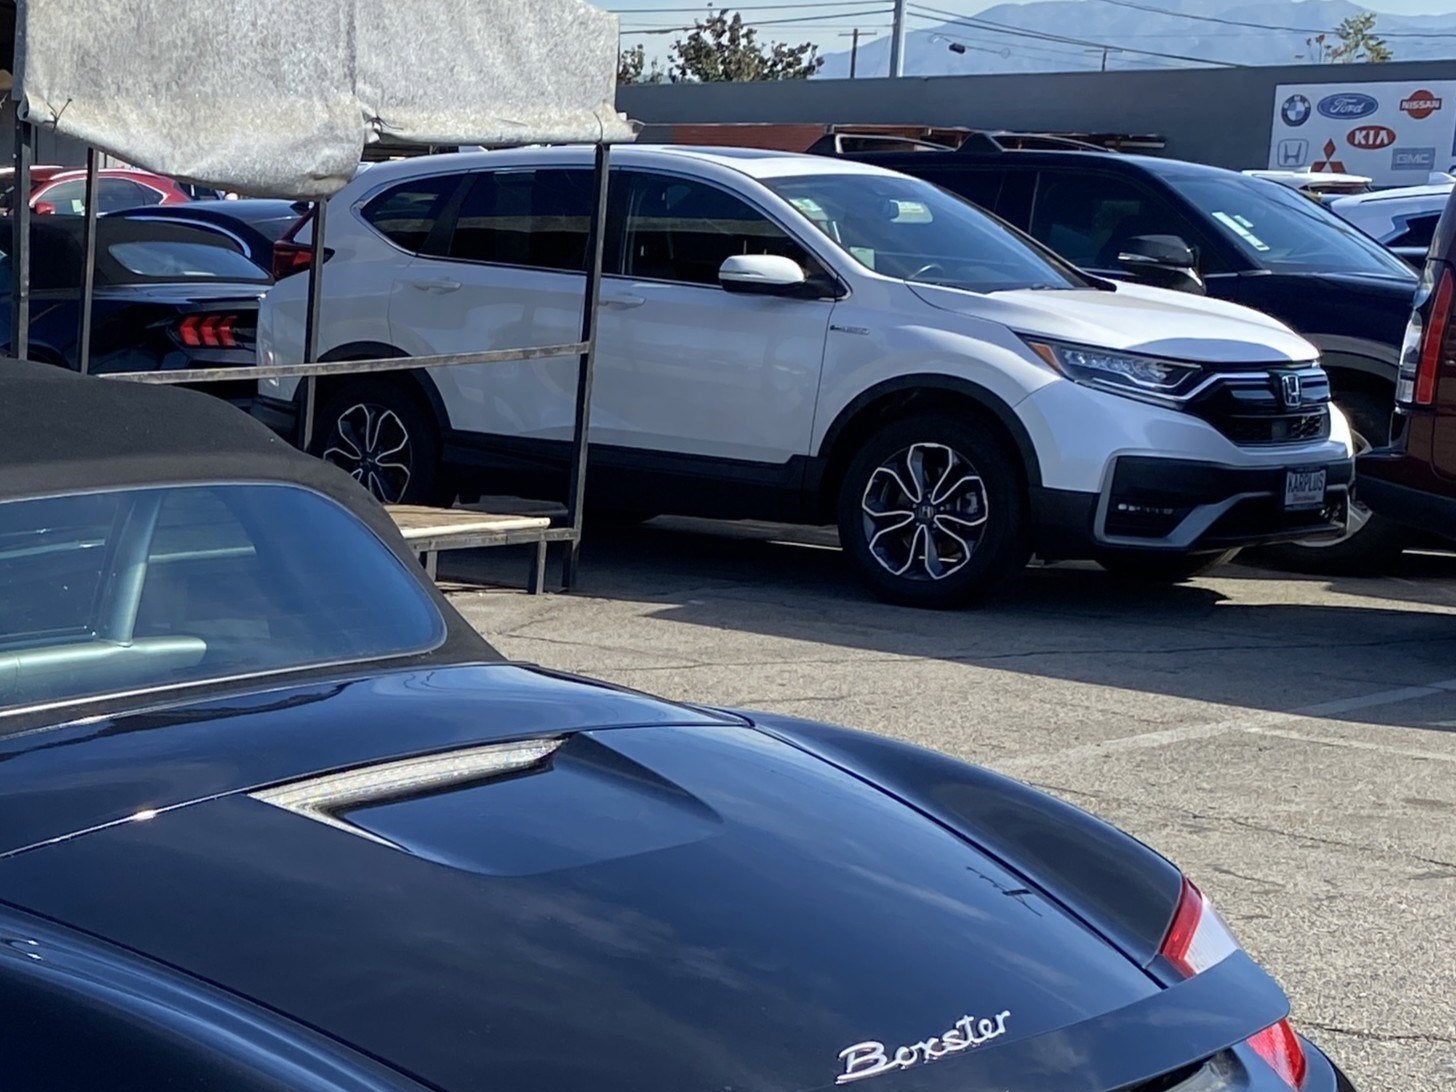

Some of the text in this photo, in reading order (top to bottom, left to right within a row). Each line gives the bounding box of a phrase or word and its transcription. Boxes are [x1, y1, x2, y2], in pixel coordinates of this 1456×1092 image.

[1330, 98, 1364, 114] Ford
[1401, 99, 1440, 110] NISSAN
[1354, 130, 1389, 145] KIA
[1396, 153, 1430, 164] GMC
[835, 1009, 1011, 1084] Boxster
